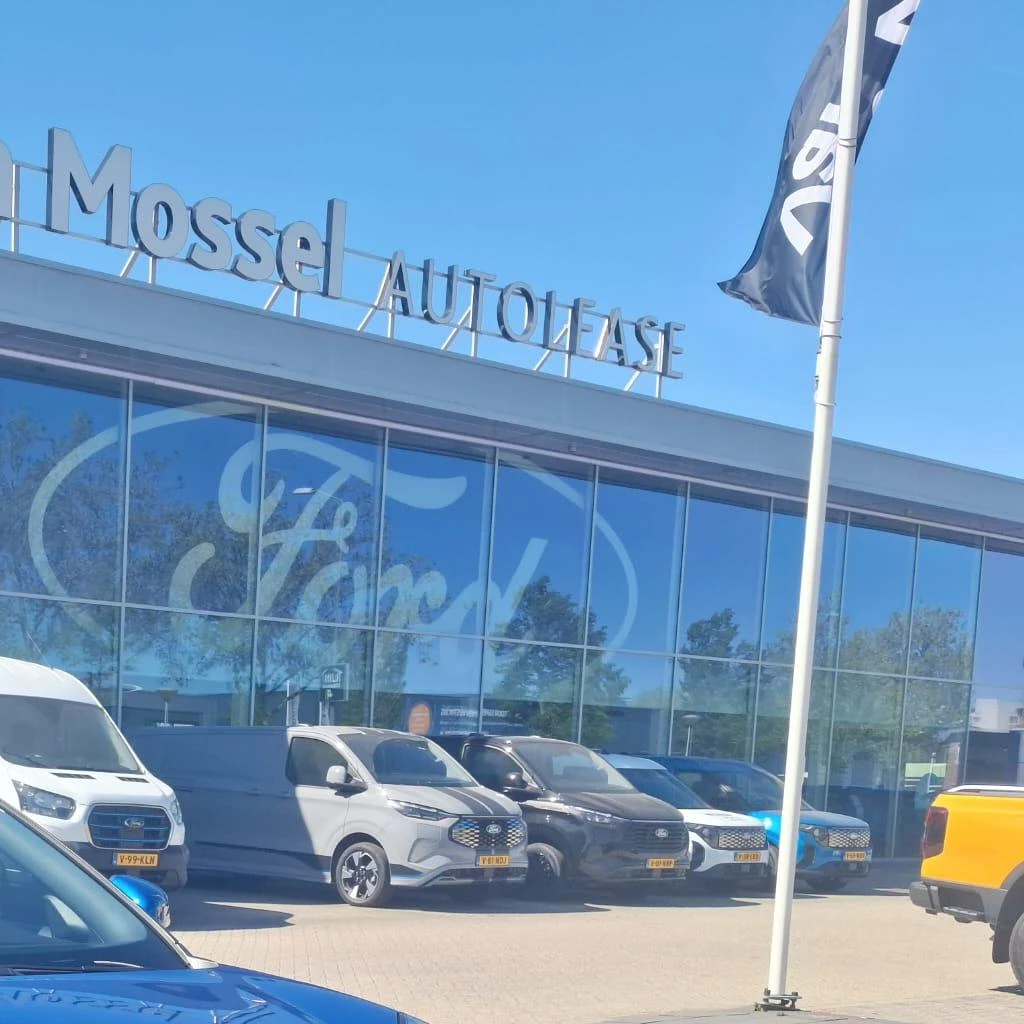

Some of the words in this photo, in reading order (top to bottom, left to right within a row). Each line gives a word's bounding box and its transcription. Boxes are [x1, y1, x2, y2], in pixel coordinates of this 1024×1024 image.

[47, 126, 347, 298] Mossel
[376, 249, 685, 379] AUTOLEASE
[169, 432, 550, 657] Ford
